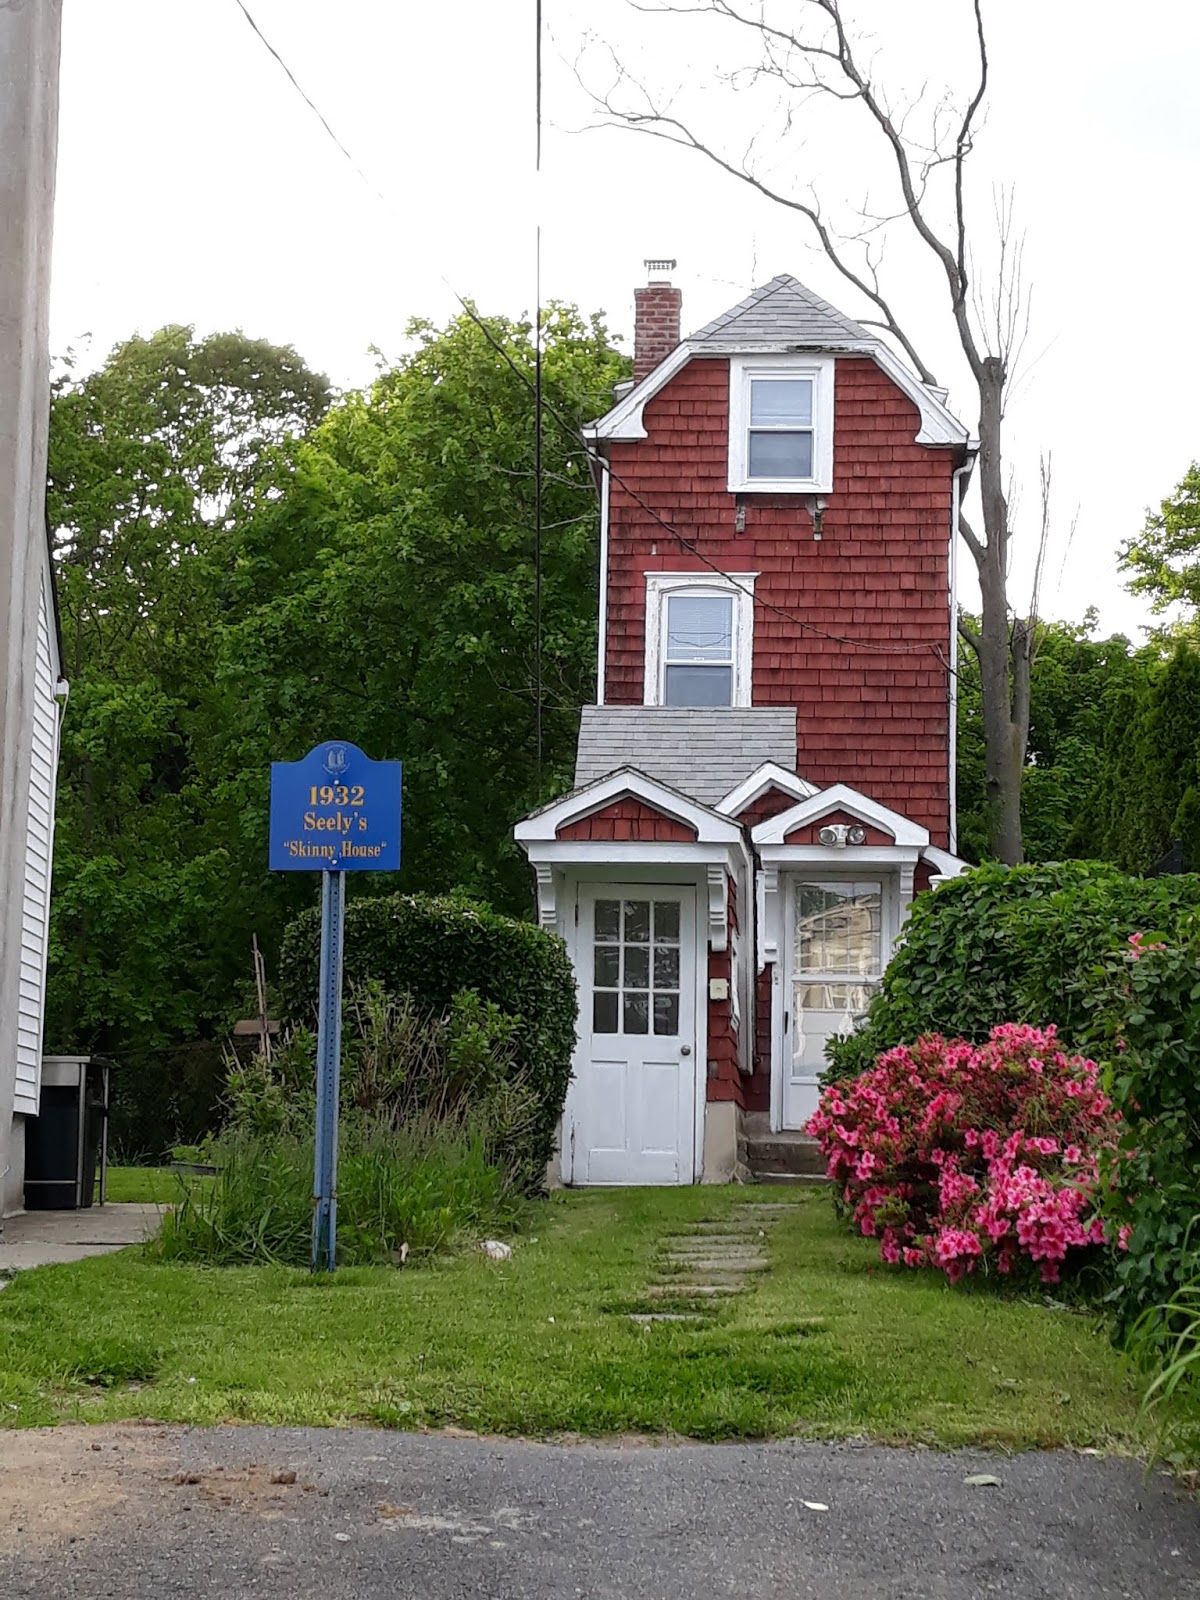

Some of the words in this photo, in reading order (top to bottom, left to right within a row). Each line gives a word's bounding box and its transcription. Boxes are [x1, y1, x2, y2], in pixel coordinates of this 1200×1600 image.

[310, 785, 365, 806] 1932
[303, 811, 368, 835] Seely's
[283, 840, 336, 860] "Skinny
[341, 840, 387, 858] House"
